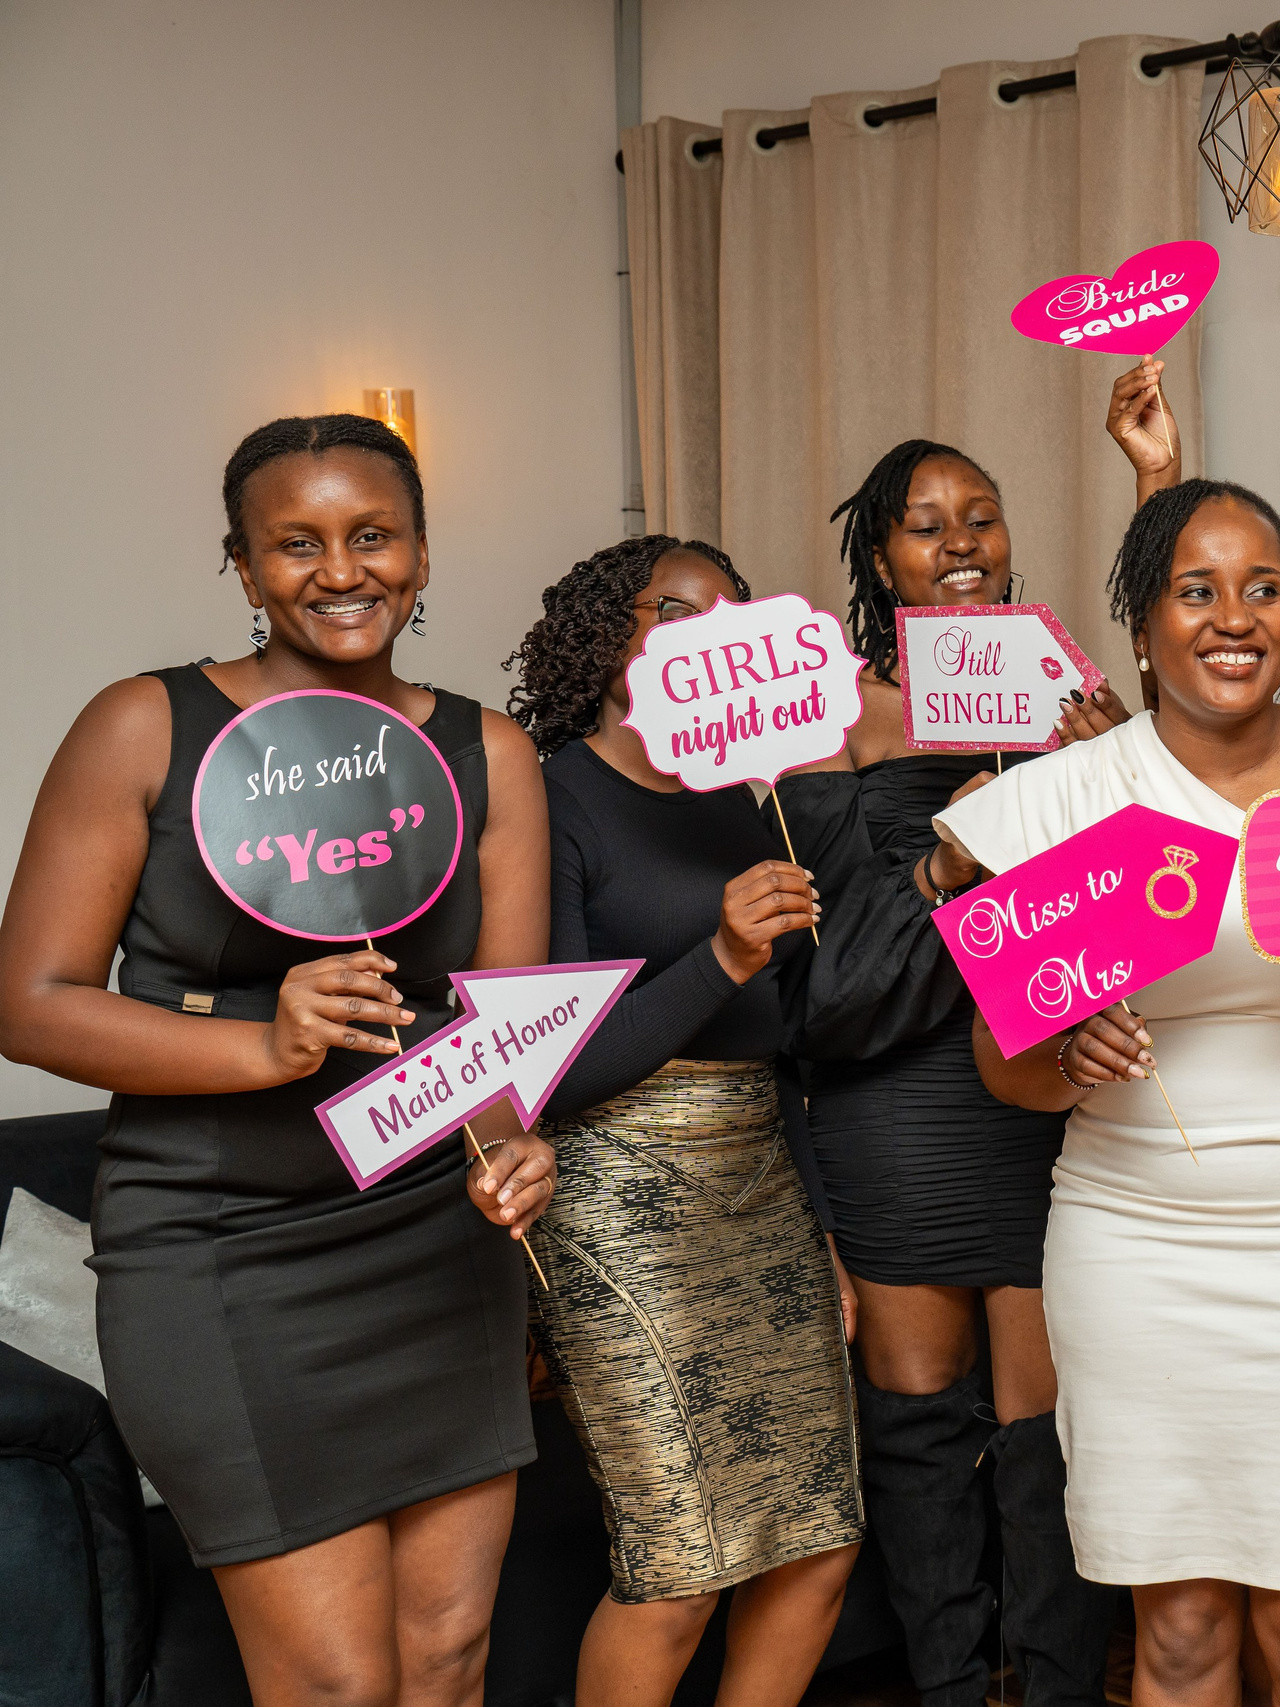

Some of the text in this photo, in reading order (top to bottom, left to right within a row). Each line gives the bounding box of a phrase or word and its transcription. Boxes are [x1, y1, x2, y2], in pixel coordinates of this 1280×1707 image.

[1046, 269, 1185, 320] Bride
[1059, 294, 1190, 345] SQUAD
[662, 623, 828, 704] GIRLS
[933, 626, 1006, 677] Still
[671, 680, 826, 766] night out
[926, 693, 1031, 726] SINGLE
[245, 724, 391, 801] she said
[958, 866, 1123, 959] Miss to
[1027, 947, 1133, 1018] Mrs
[367, 994, 581, 1145] Maid of Honor
